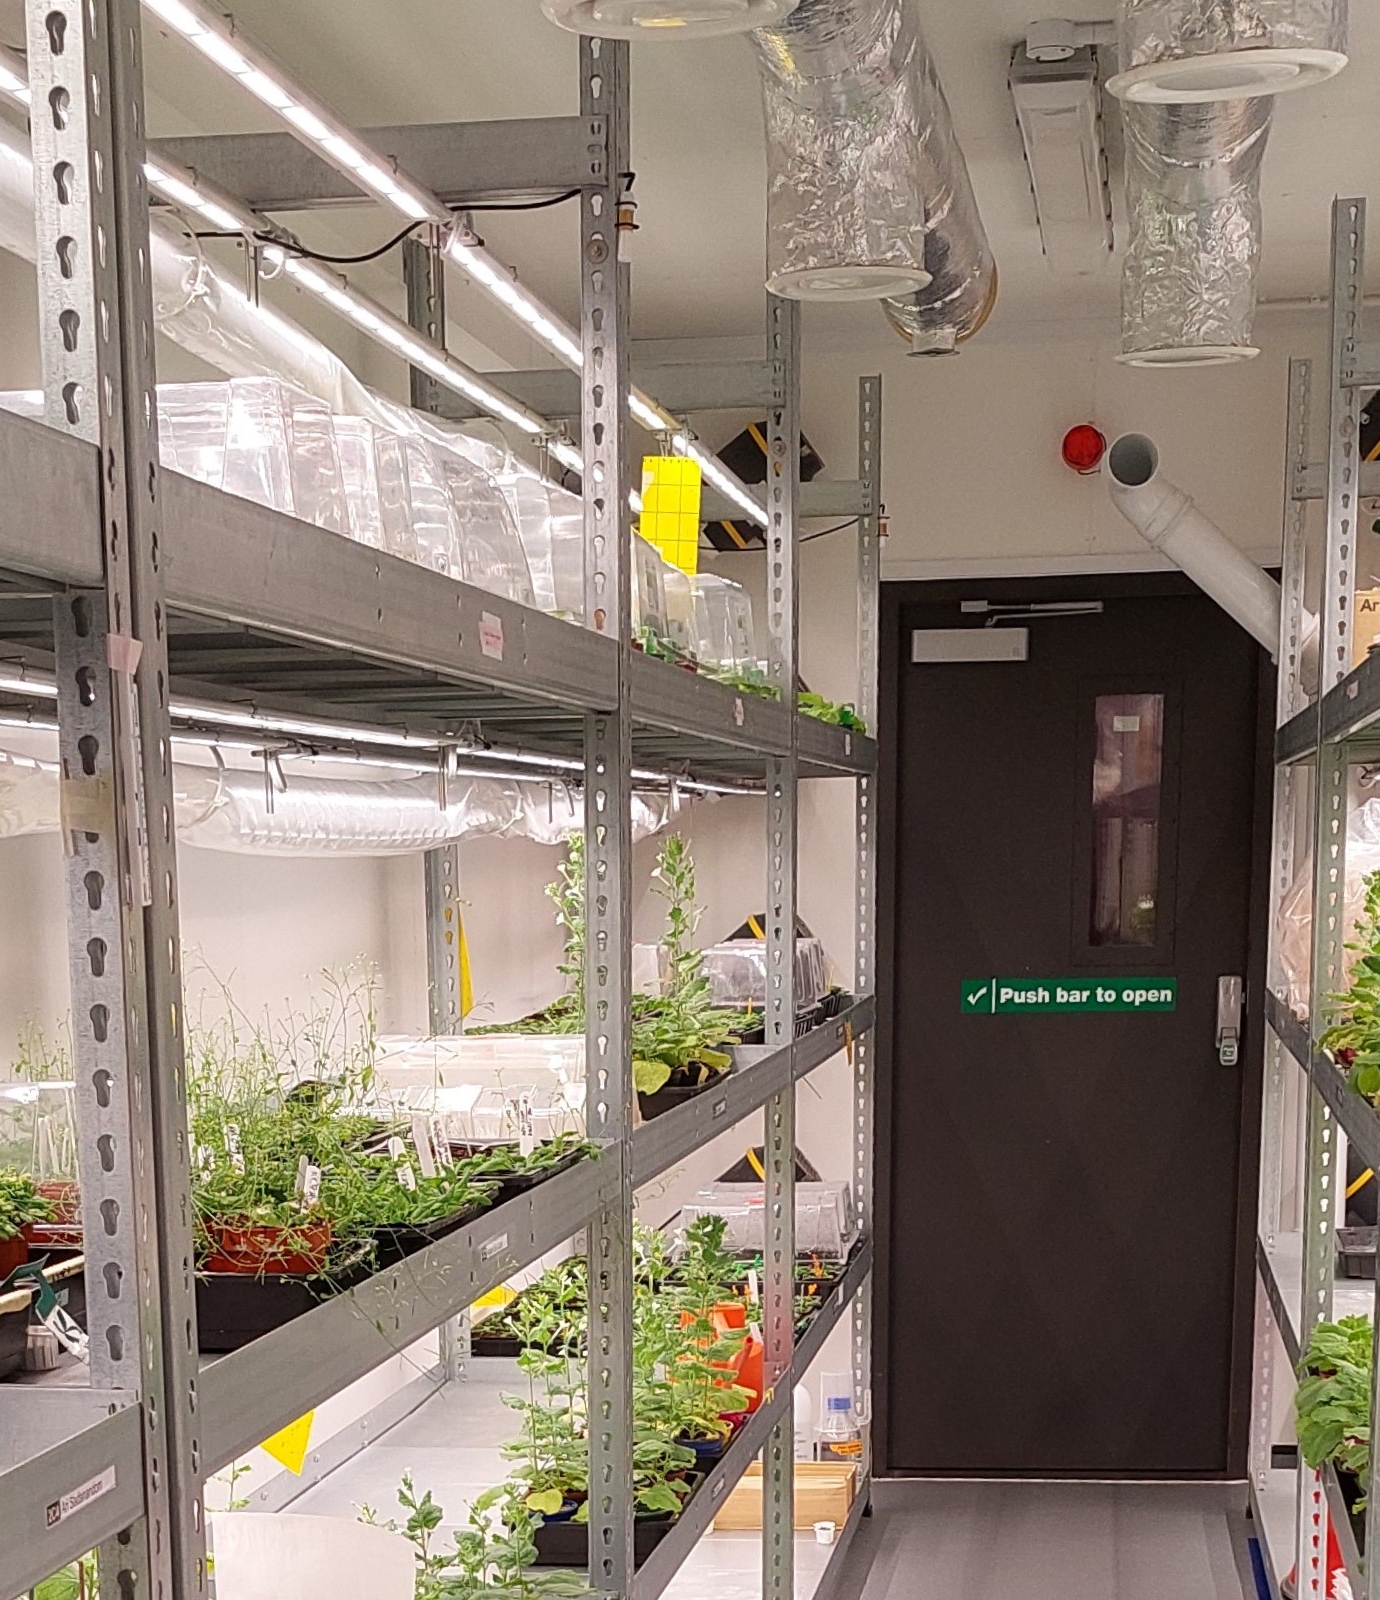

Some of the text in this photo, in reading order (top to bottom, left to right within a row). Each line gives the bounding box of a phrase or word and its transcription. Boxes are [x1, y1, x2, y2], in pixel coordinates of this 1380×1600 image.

[999, 986, 1173, 1006] Push bar to open
